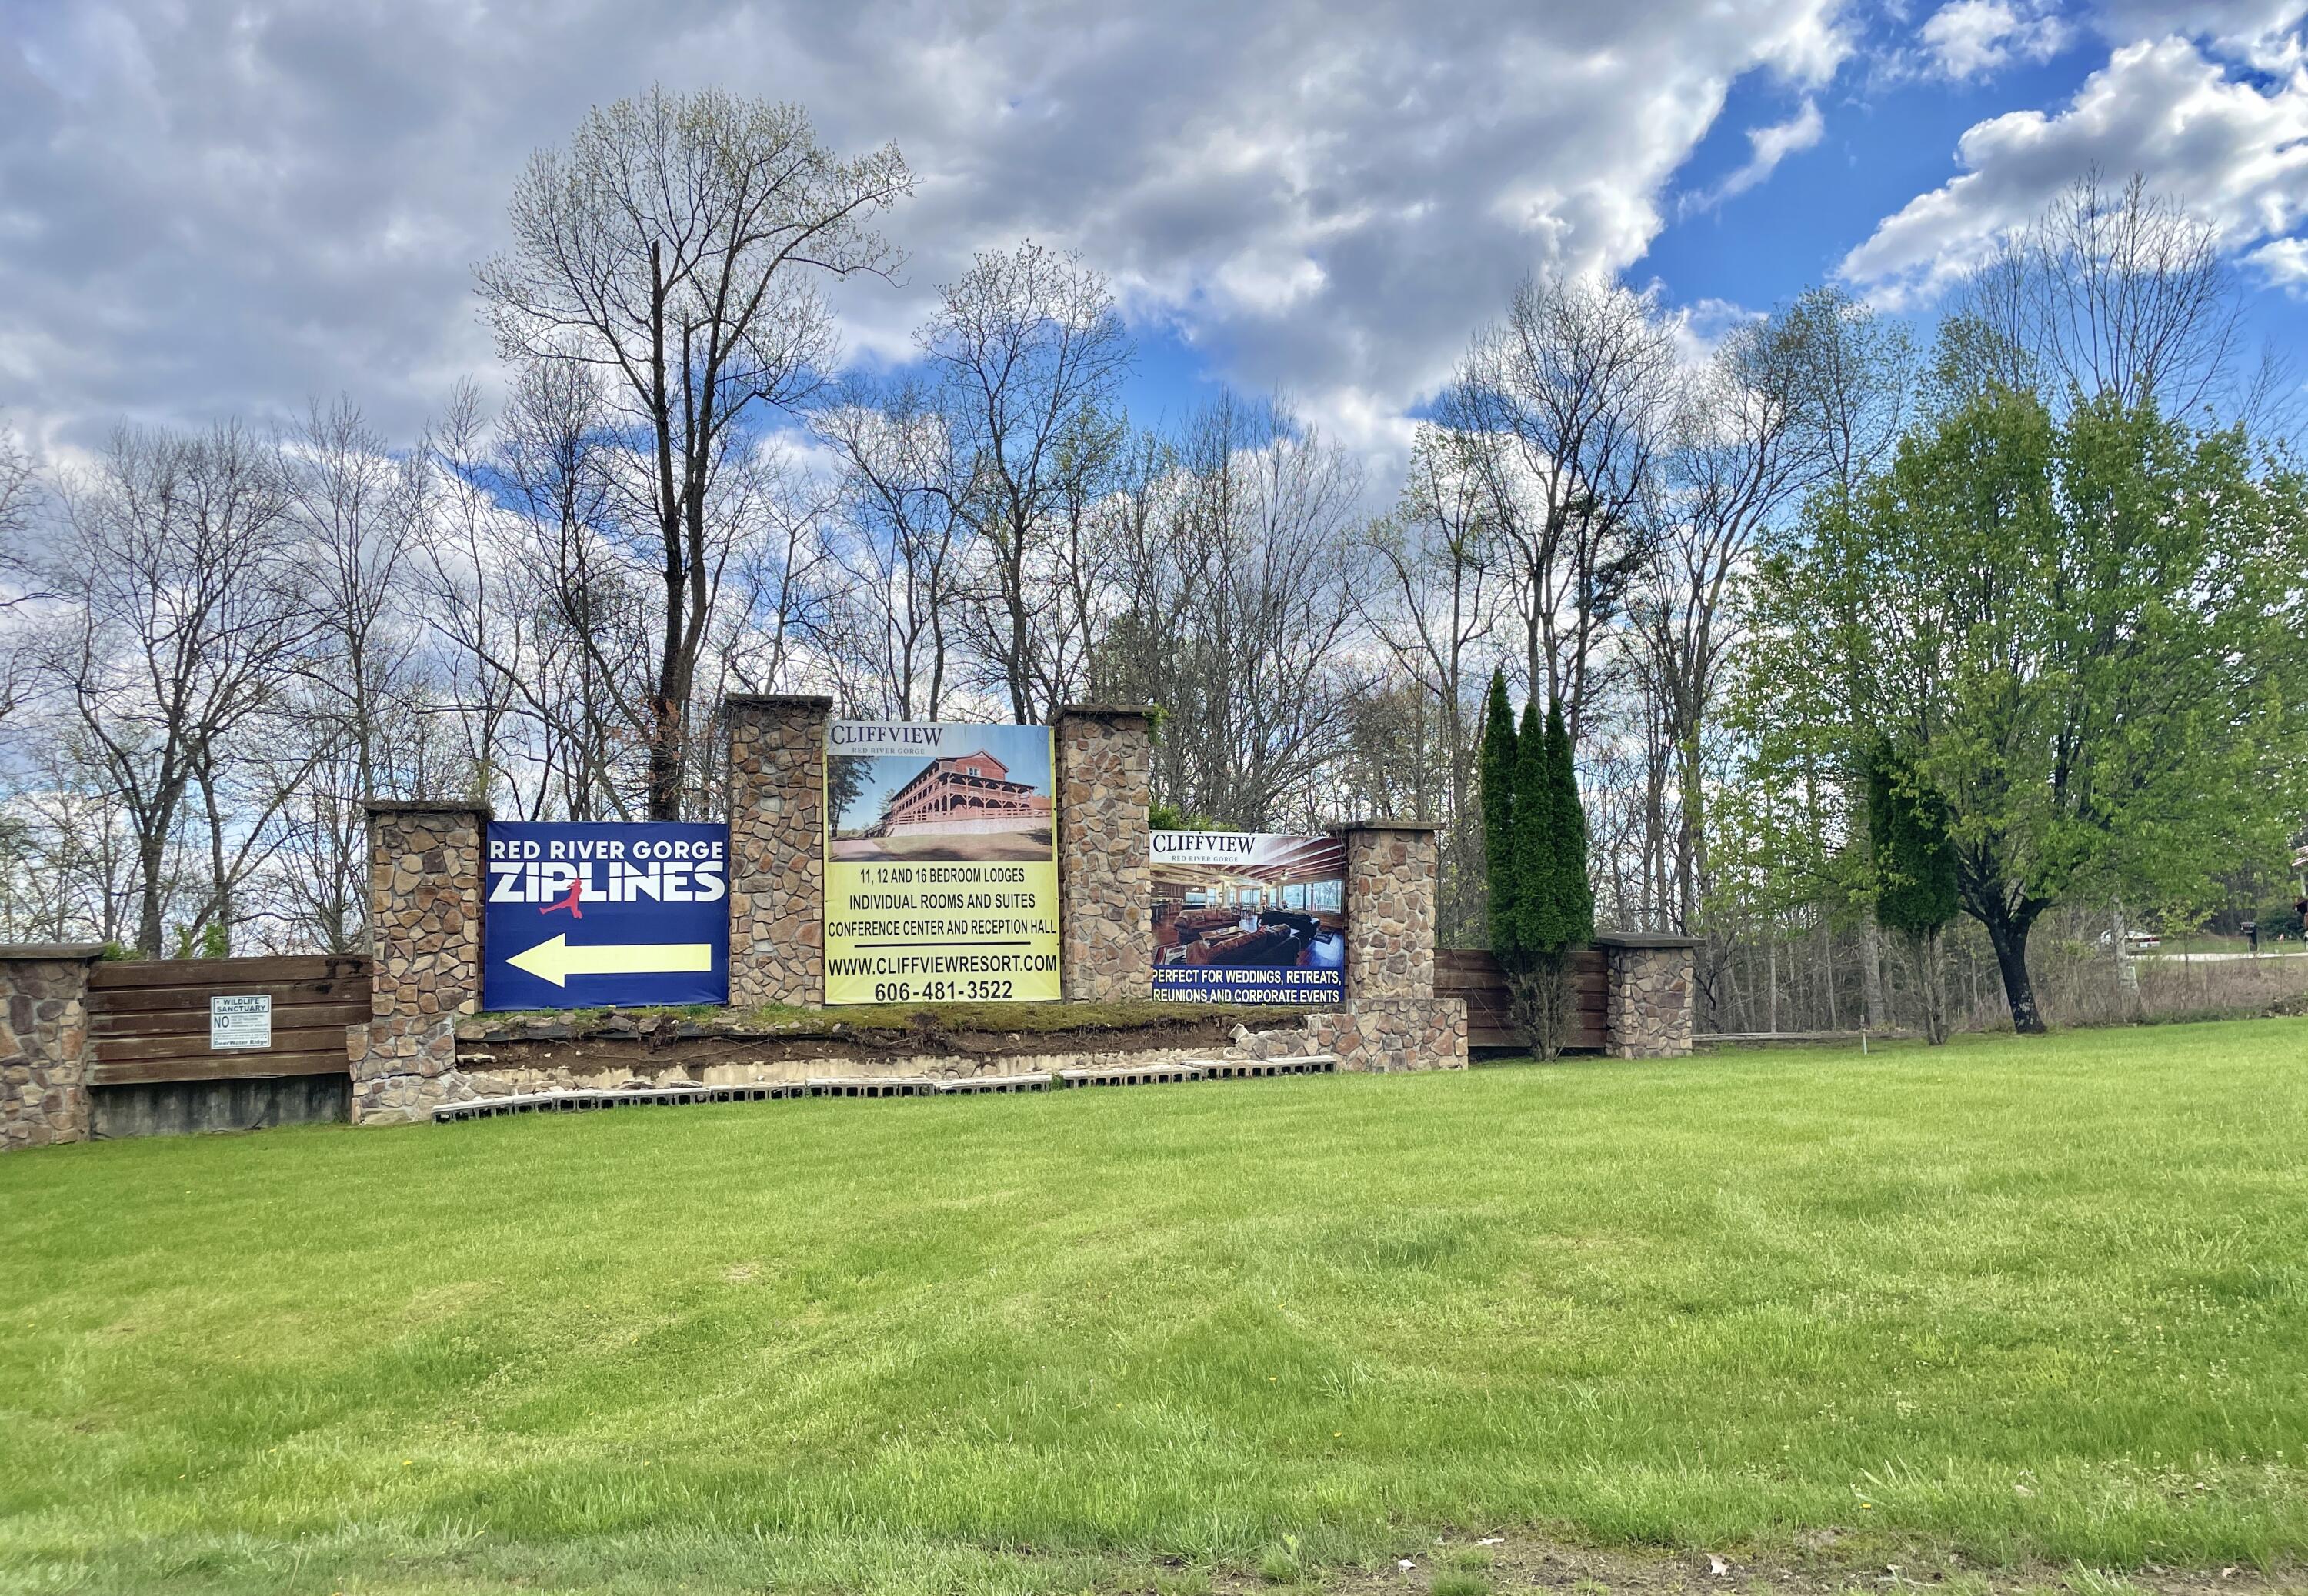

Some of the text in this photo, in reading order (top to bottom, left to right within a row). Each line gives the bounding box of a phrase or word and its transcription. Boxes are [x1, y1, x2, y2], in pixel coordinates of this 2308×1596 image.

[831, 725, 943, 747] CLIFFVIEW
[490, 841, 723, 859] RED RIVER GORGE
[1153, 835, 1256, 855] CLIFFVIEW
[489, 861, 725, 902] ZIPLINES
[860, 868, 1025, 886] 11, 12 AND 16 BEDROOM LODGES
[849, 893, 1036, 910] INDIVIDUAL ROOMS AND SUITES
[828, 919, 1056, 937] CONFERENCE CENTER AND RECEPTION HALL
[828, 955, 1057, 976] WWW.CLIFFVIEWRESORT.COM
[1152, 969, 1341, 986] PERFECT FOR WEDDINGS, RETREATS,
[875, 980, 1013, 1001] 606-481-3522
[1153, 988, 1339, 1003] REUNIONS AND CORPORATE EVENTS
[214, 1015, 229, 1028] NO
